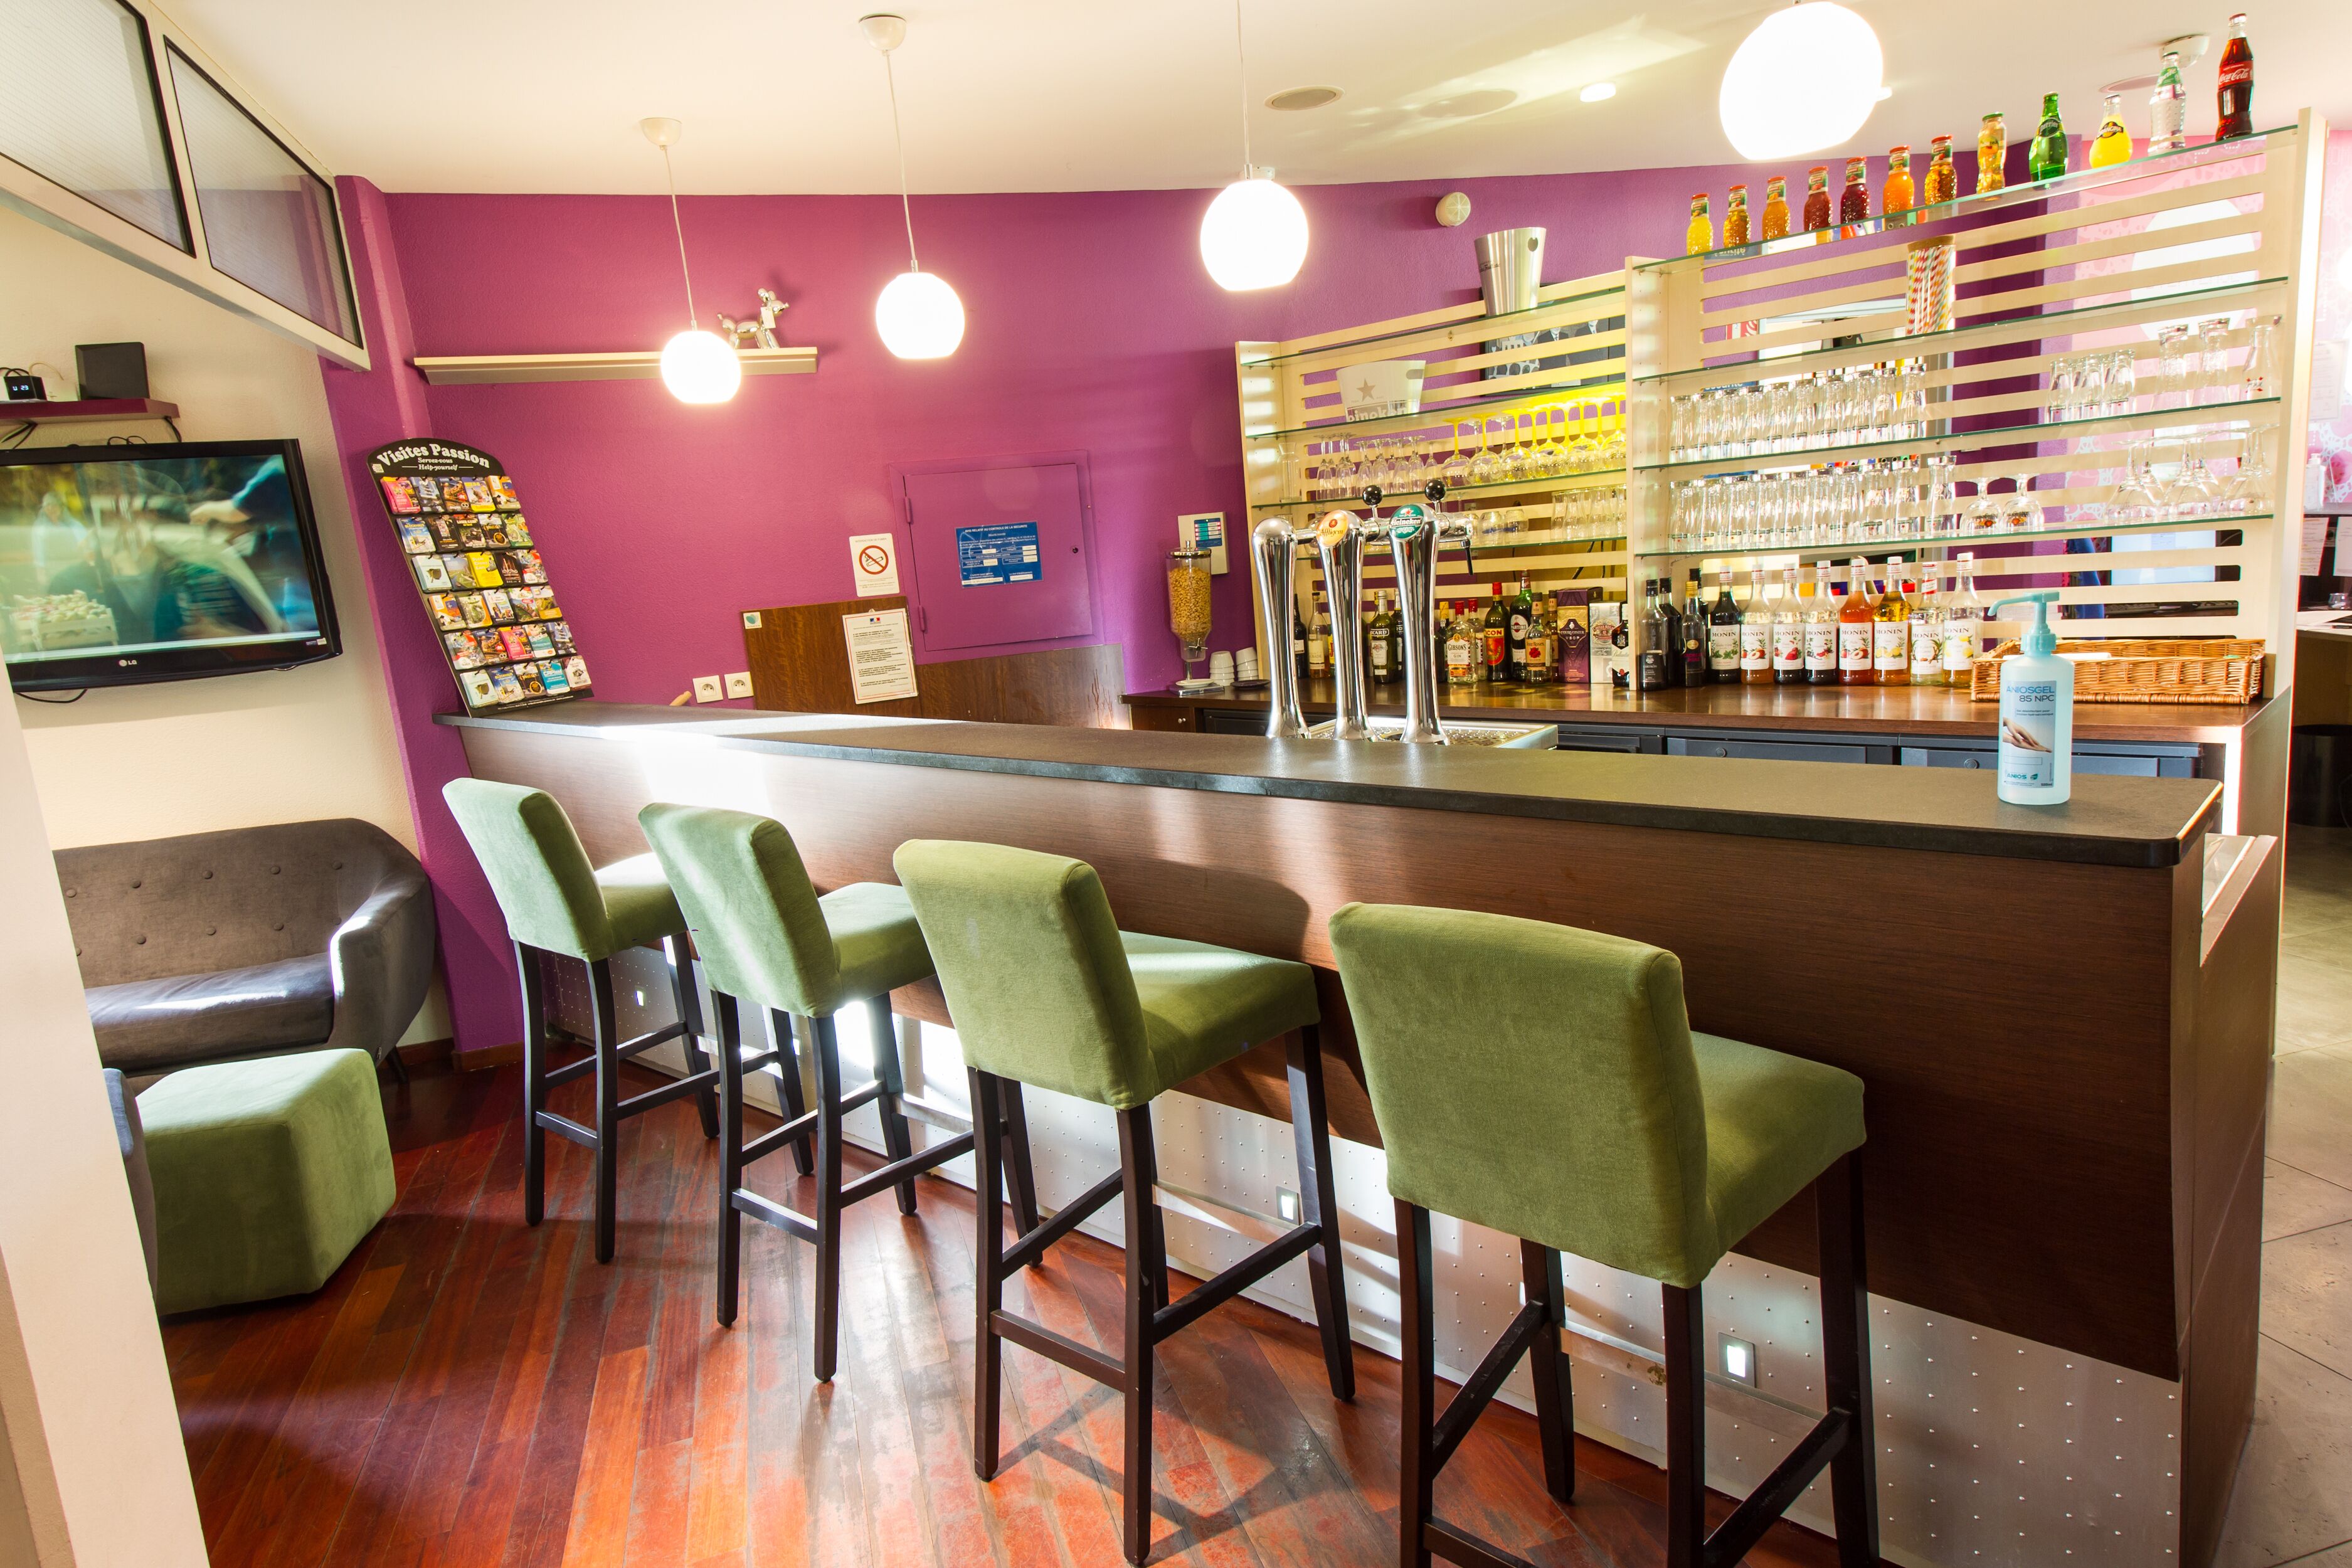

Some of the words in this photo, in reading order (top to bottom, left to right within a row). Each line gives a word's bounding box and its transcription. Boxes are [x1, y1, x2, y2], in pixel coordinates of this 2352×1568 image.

[377, 446, 429, 467] Visites
[429, 443, 490, 469] Passion
[1391, 518, 1422, 526] Heineken
[1320, 527, 1343, 537] Affligem
